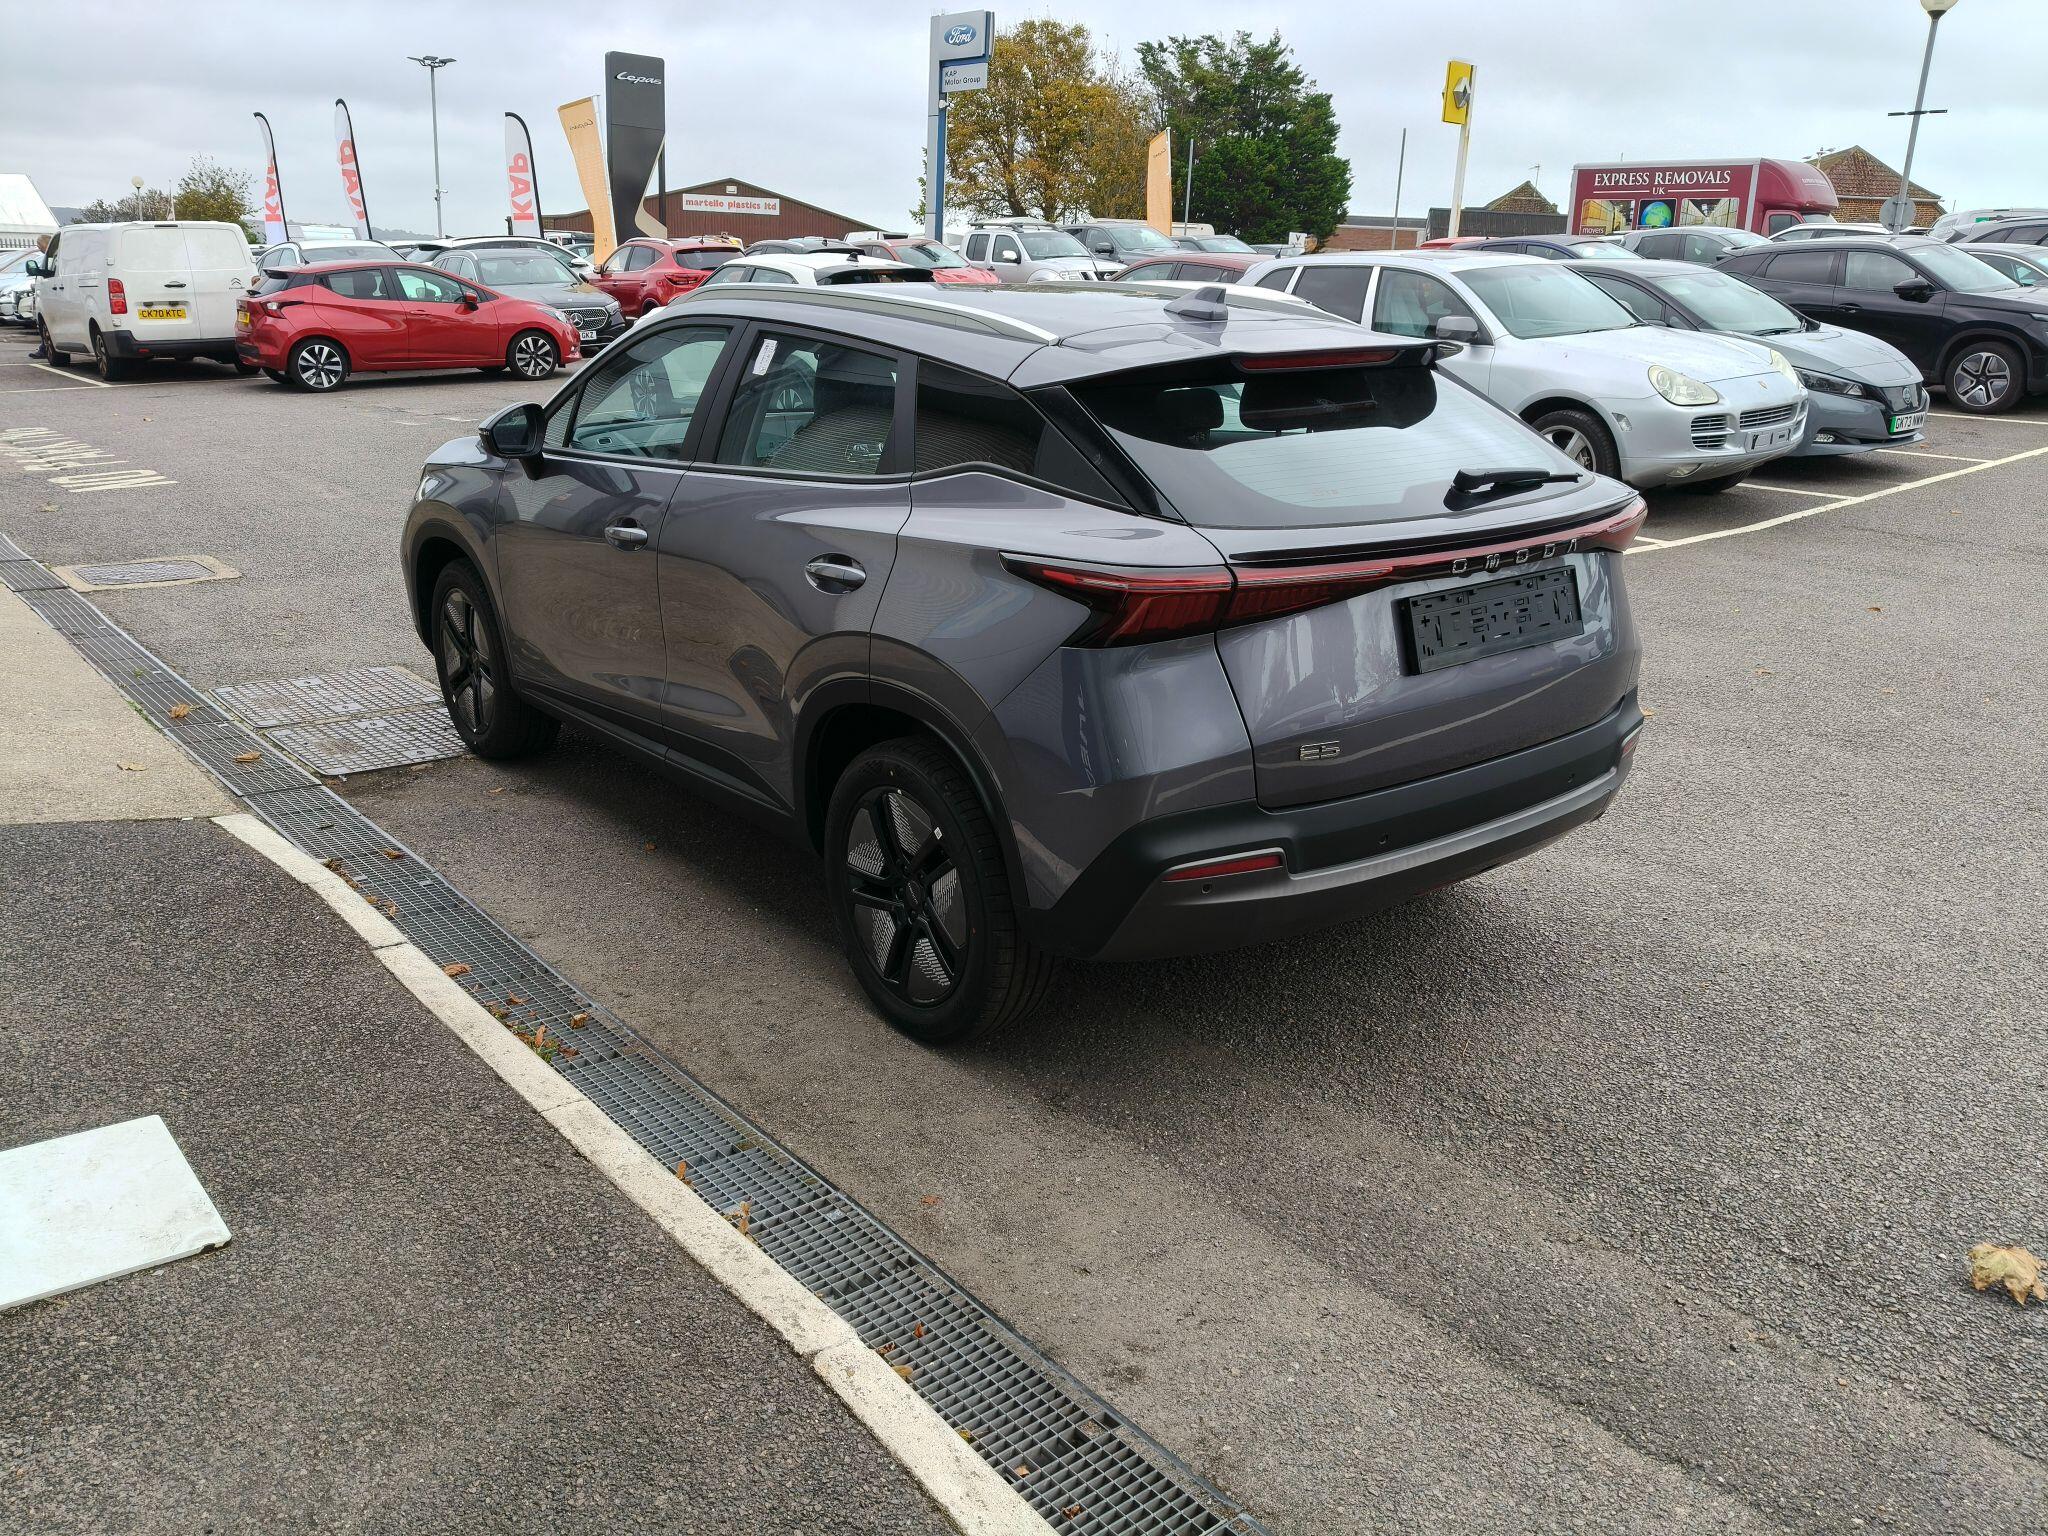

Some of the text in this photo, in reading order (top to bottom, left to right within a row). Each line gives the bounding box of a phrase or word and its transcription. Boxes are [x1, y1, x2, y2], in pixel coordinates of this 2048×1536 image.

[949, 26, 973, 44] Ford
[945, 78, 961, 86] Motor
[1594, 170, 1731, 186] EXPRESS REMOVALS
[1652, 187, 1666, 195] UK
[685, 199, 777, 211] martello plastics ltd
[1582, 226, 1605, 234] movers
